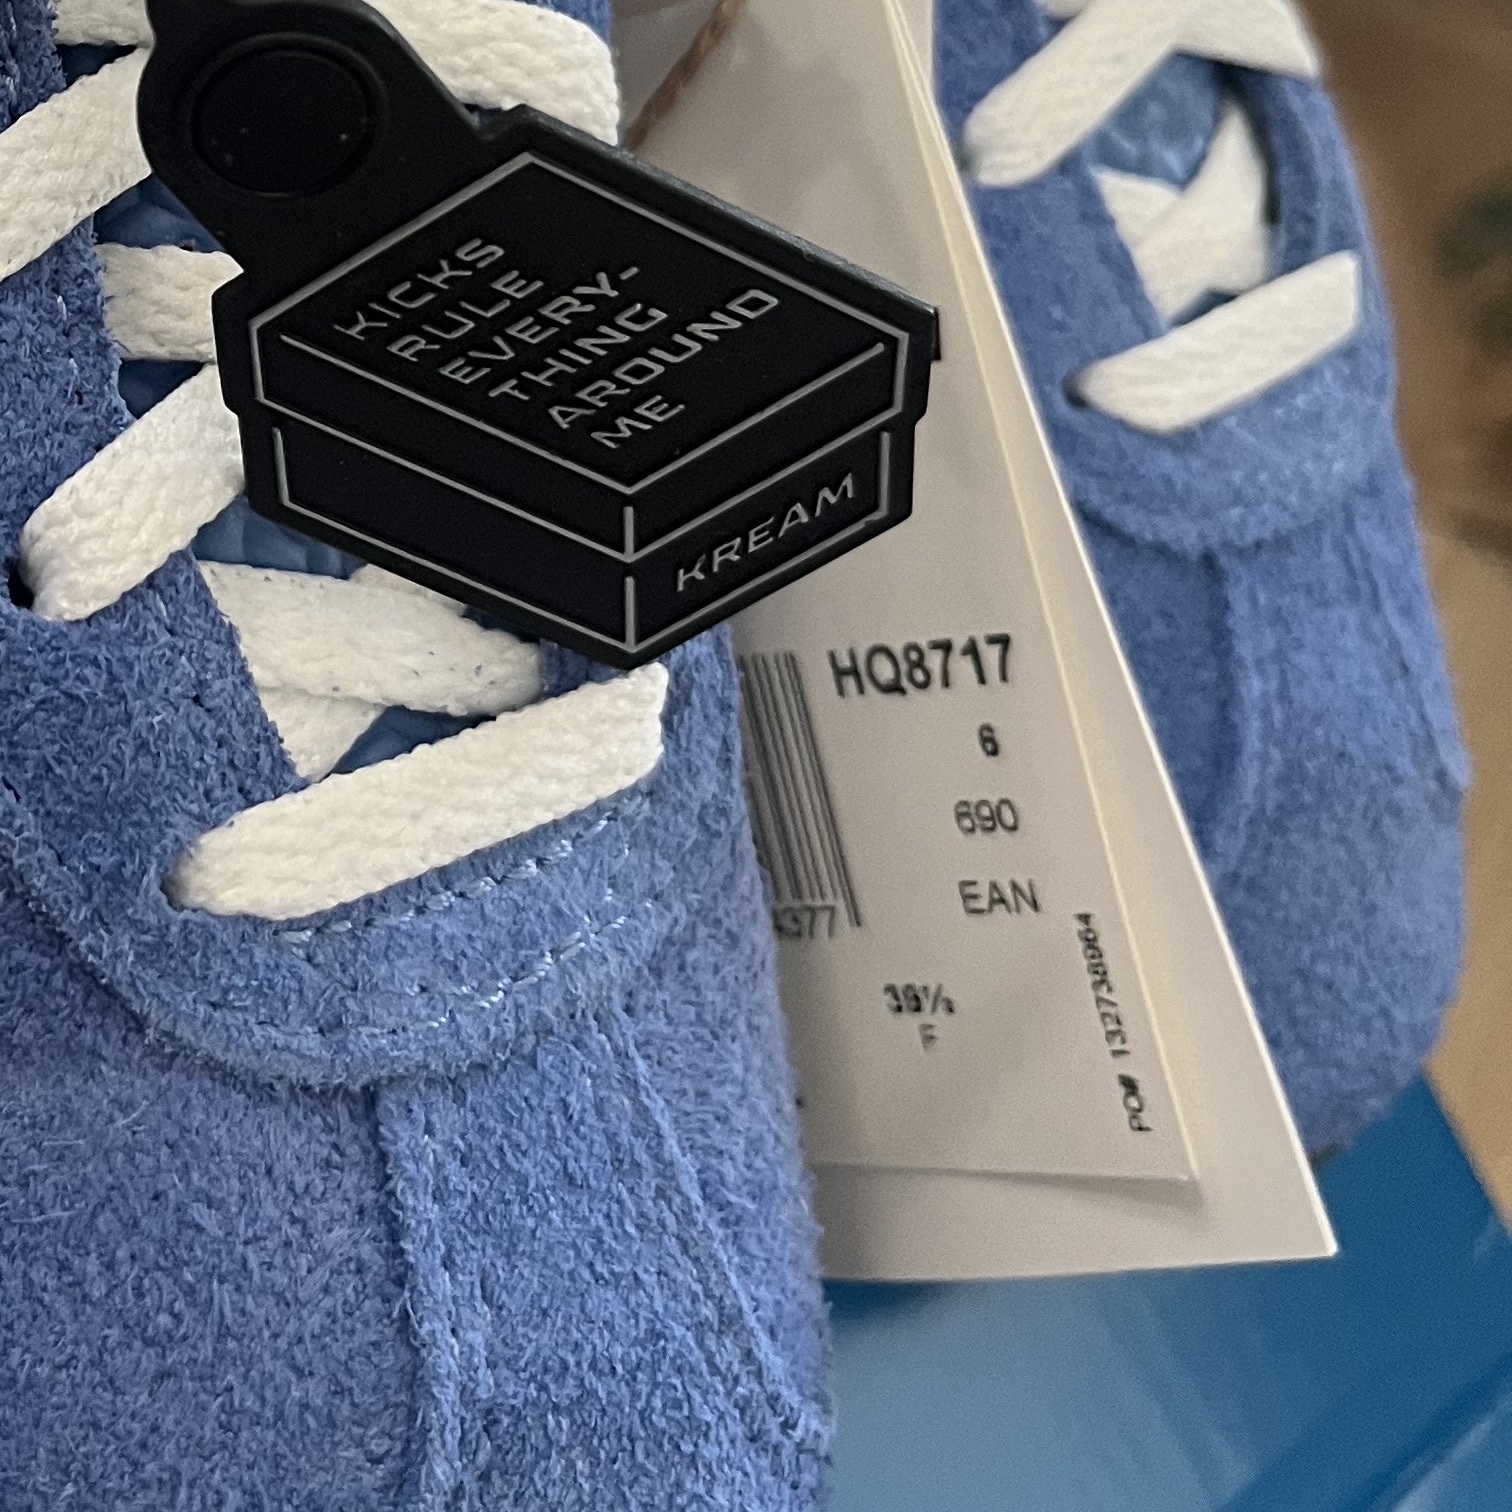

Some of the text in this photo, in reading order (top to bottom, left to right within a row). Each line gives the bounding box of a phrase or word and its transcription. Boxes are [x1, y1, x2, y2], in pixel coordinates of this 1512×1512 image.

[334, 237, 506, 340] KICKS
[386, 276, 544, 363] RULE
[438, 265, 640, 385] EVERY-
[489, 302, 670, 401] THING
[547, 288, 780, 429] AROUND
[592, 400, 686, 449] ME
[675, 471, 854, 592] KREAM
[827, 633, 1011, 699] HQ8717
[978, 723, 1000, 758] 6
[954, 798, 1020, 835] 690
[958, 878, 1041, 915] EAN
